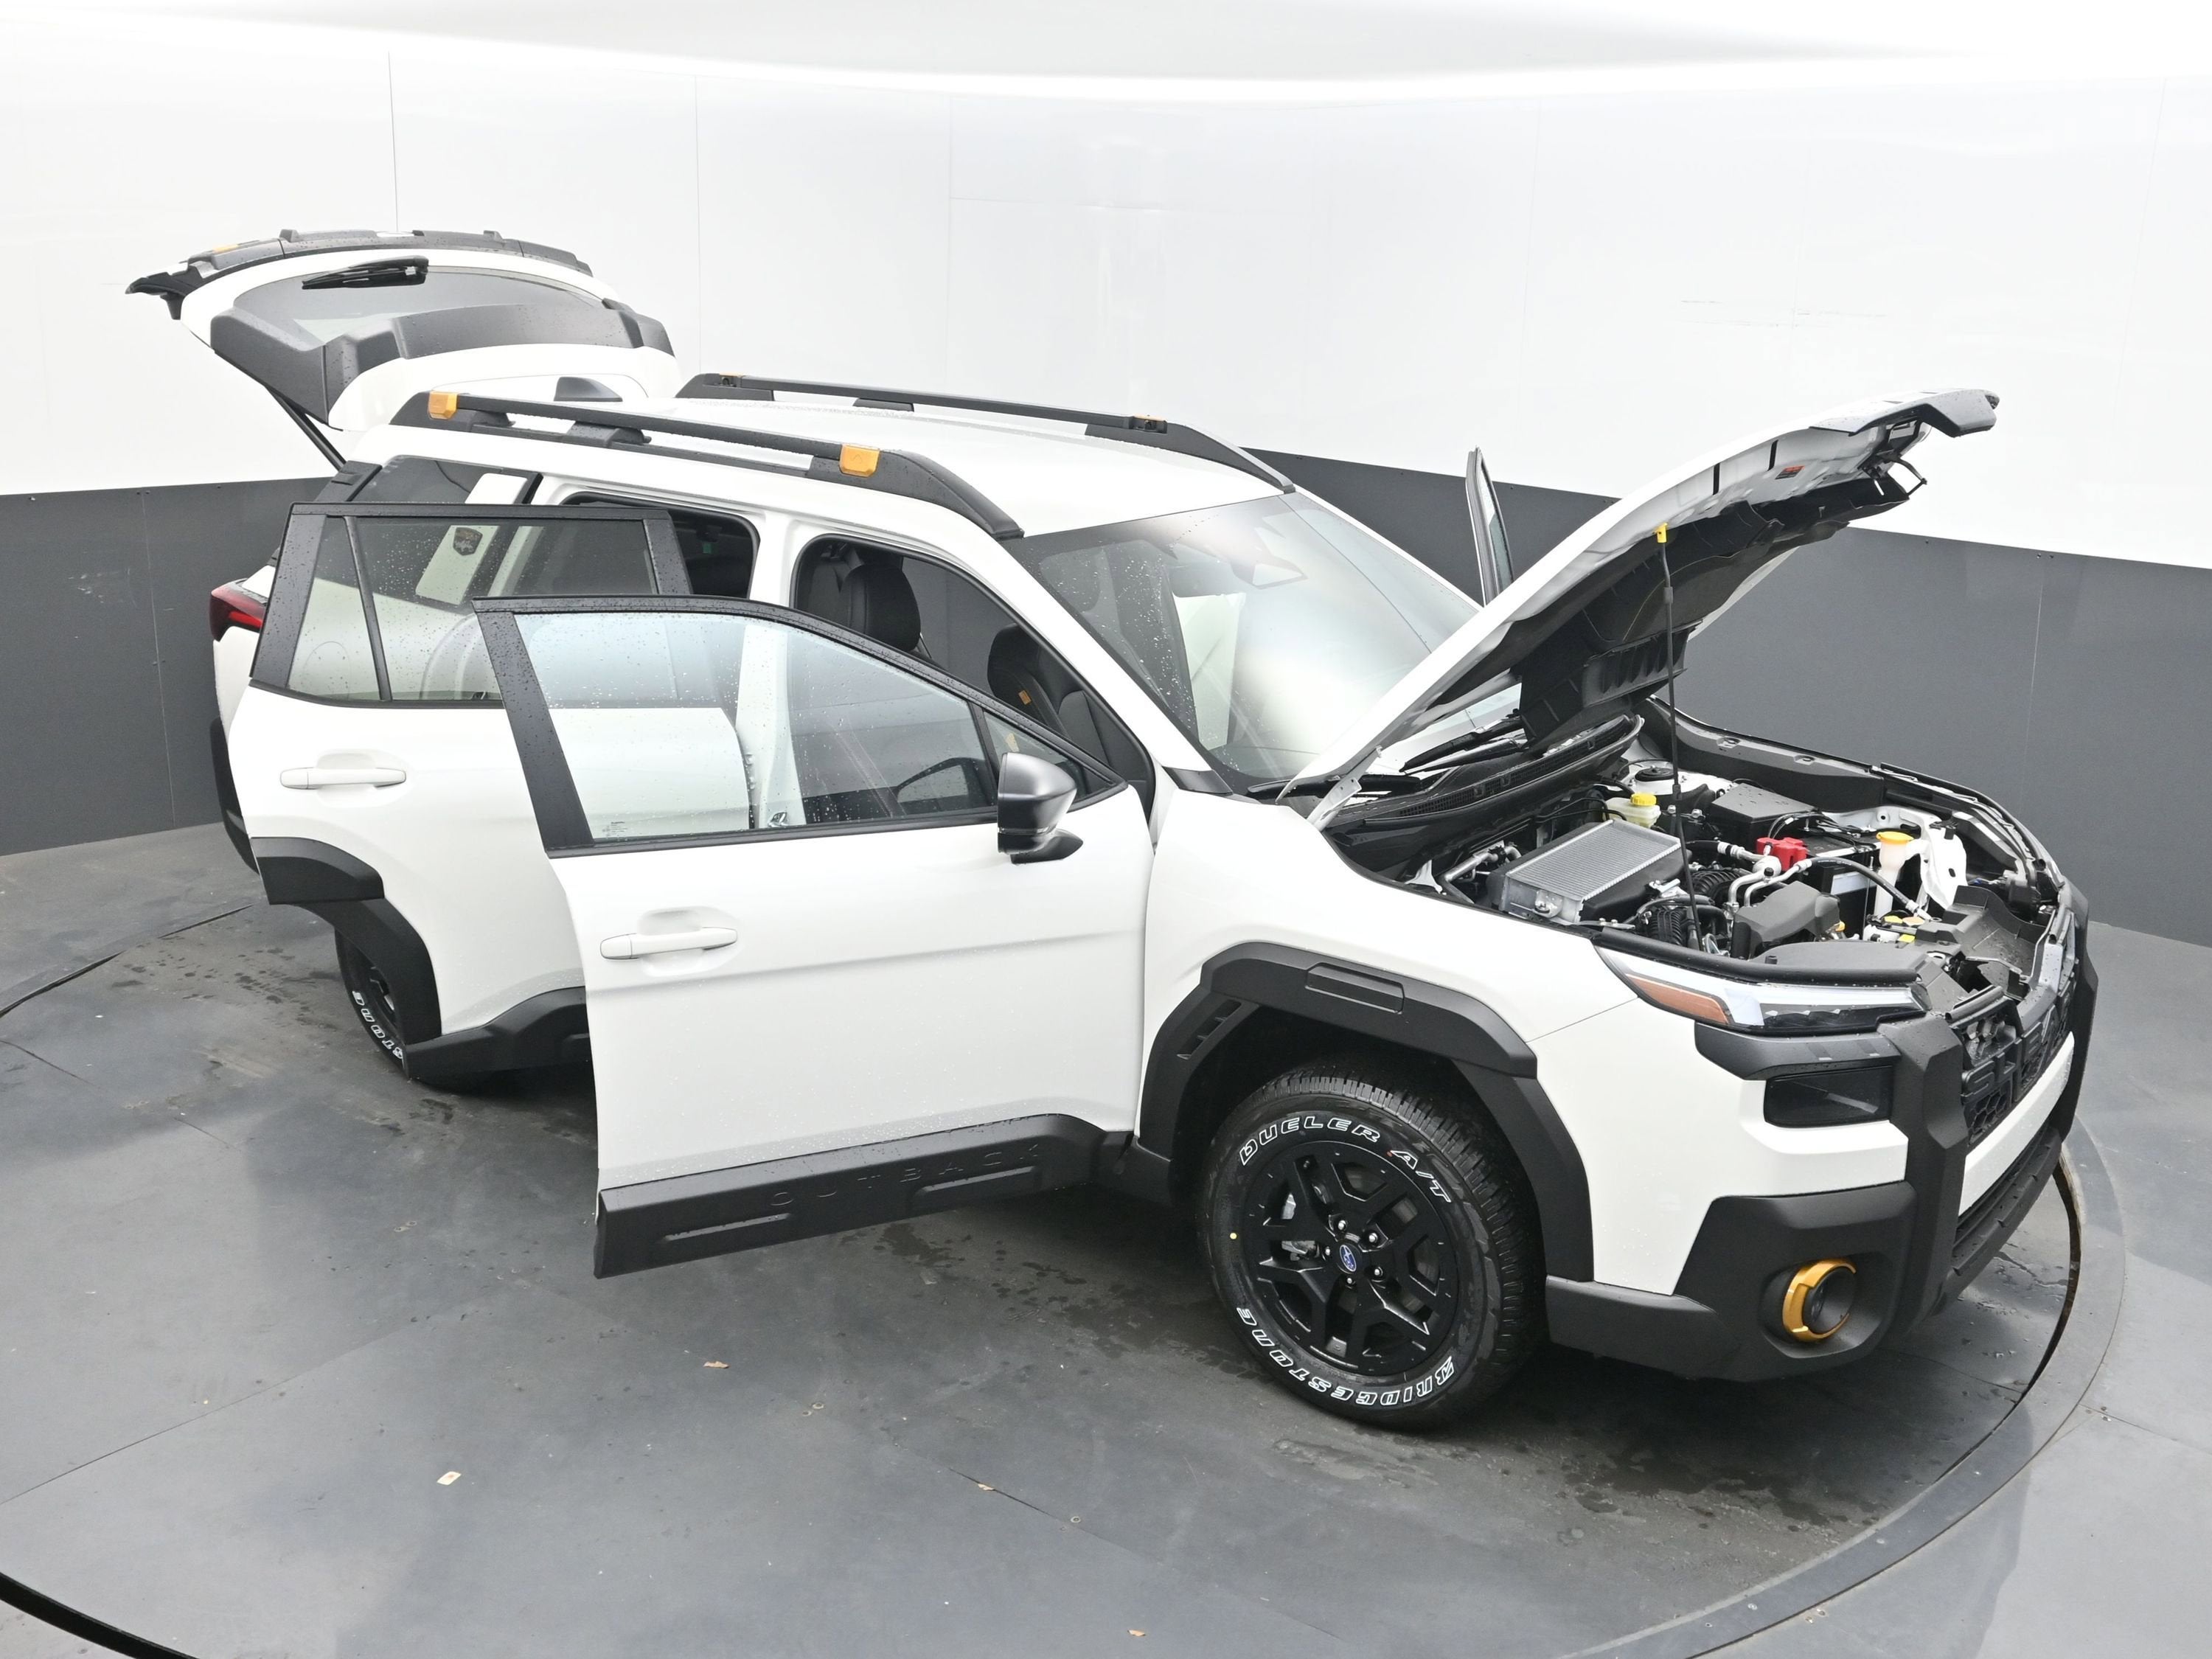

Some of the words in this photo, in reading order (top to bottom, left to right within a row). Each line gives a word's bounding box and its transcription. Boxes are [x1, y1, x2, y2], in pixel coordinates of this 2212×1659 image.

[352, 990, 404, 1060] STONE
[1239, 1116, 1380, 1166] DUELER
[1390, 1150, 1452, 1203] A/T
[1236, 1307, 1455, 1406] BRIDGESTONE
